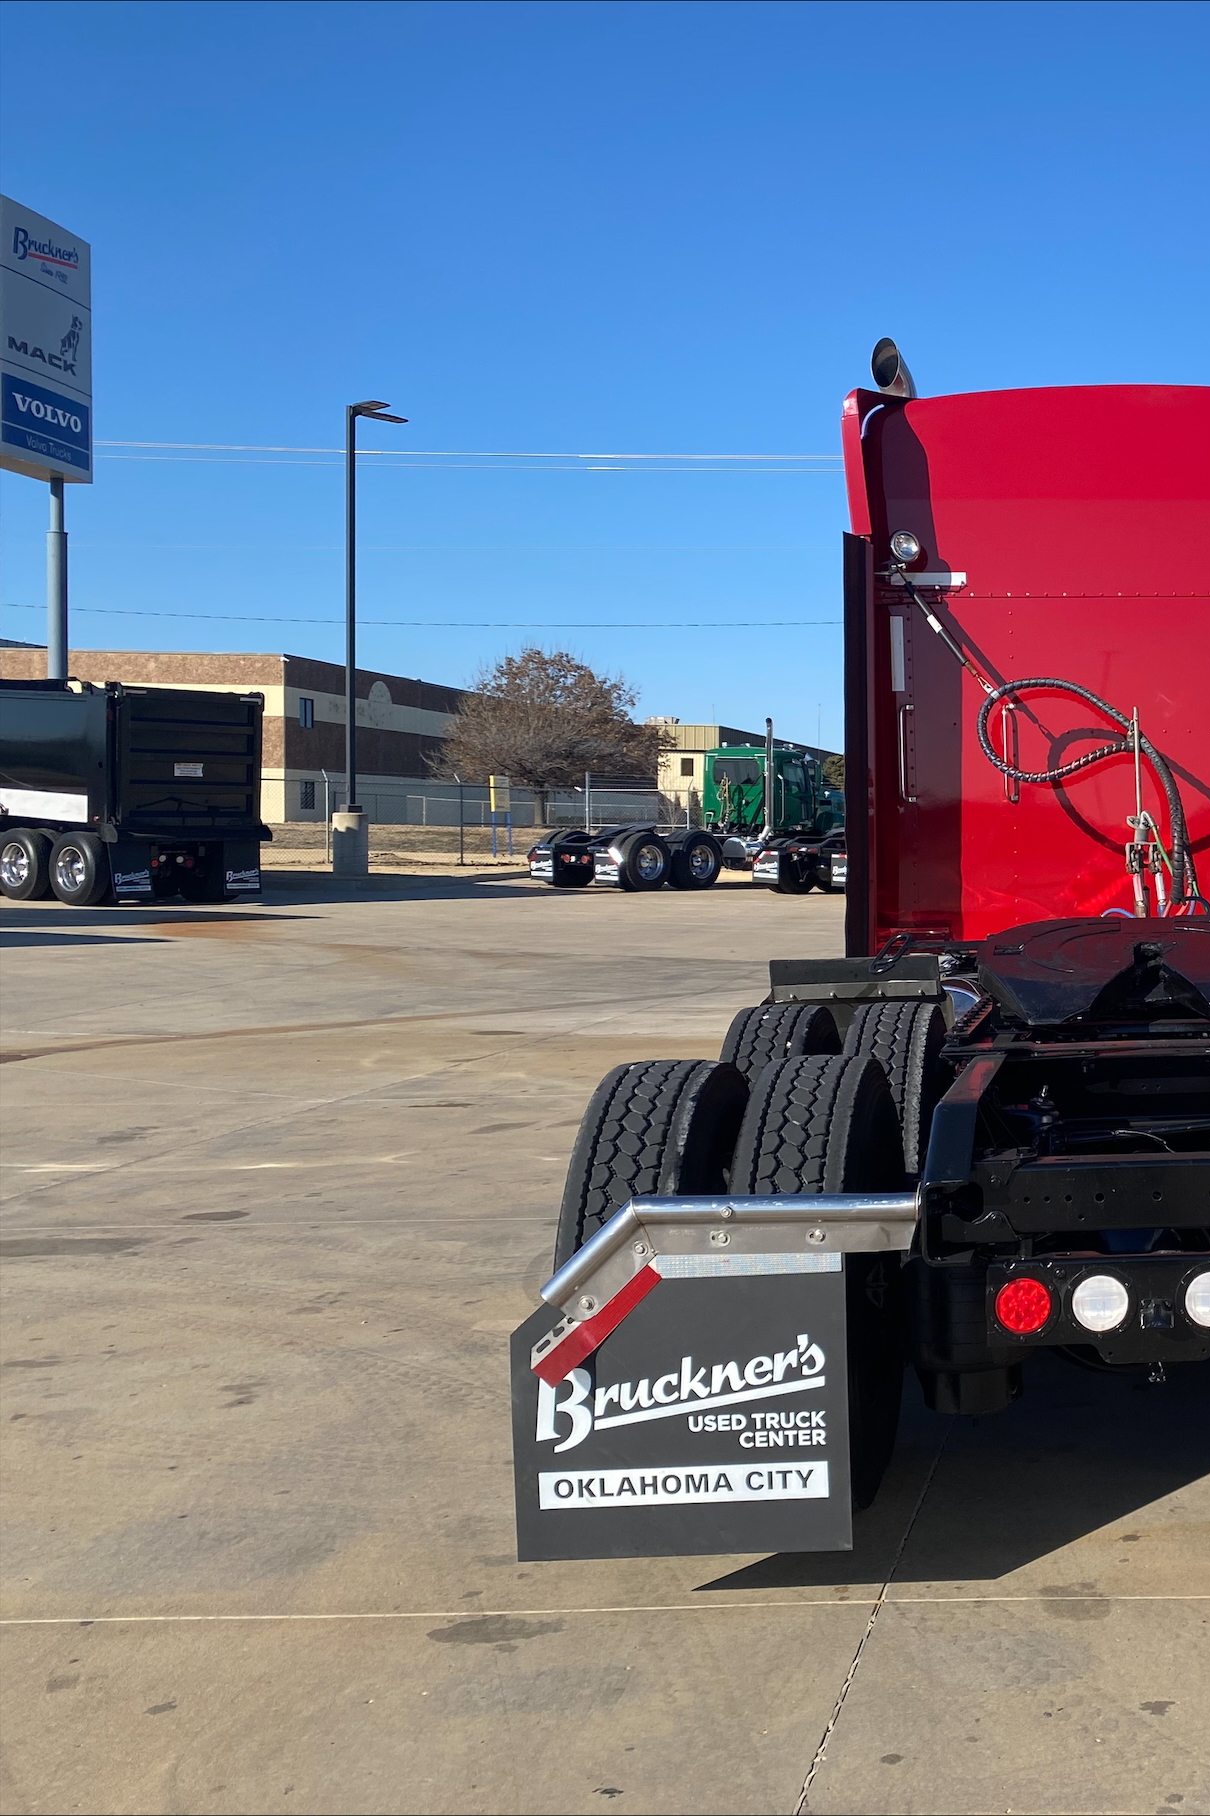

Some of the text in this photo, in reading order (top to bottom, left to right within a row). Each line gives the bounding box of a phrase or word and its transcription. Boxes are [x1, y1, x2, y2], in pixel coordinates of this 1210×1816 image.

[13, 226, 79, 264] Bruckner's
[7, 335, 78, 377] MACK
[12, 392, 82, 433] VOLVO
[26, 434, 72, 461] Volvo Trucks
[535, 1333, 826, 1454] Bruckner's
[688, 1410, 827, 1433] USED TRUCK
[739, 1429, 827, 1449] CENTER
[553, 1468, 815, 1500] OKLAHOMA CITY
